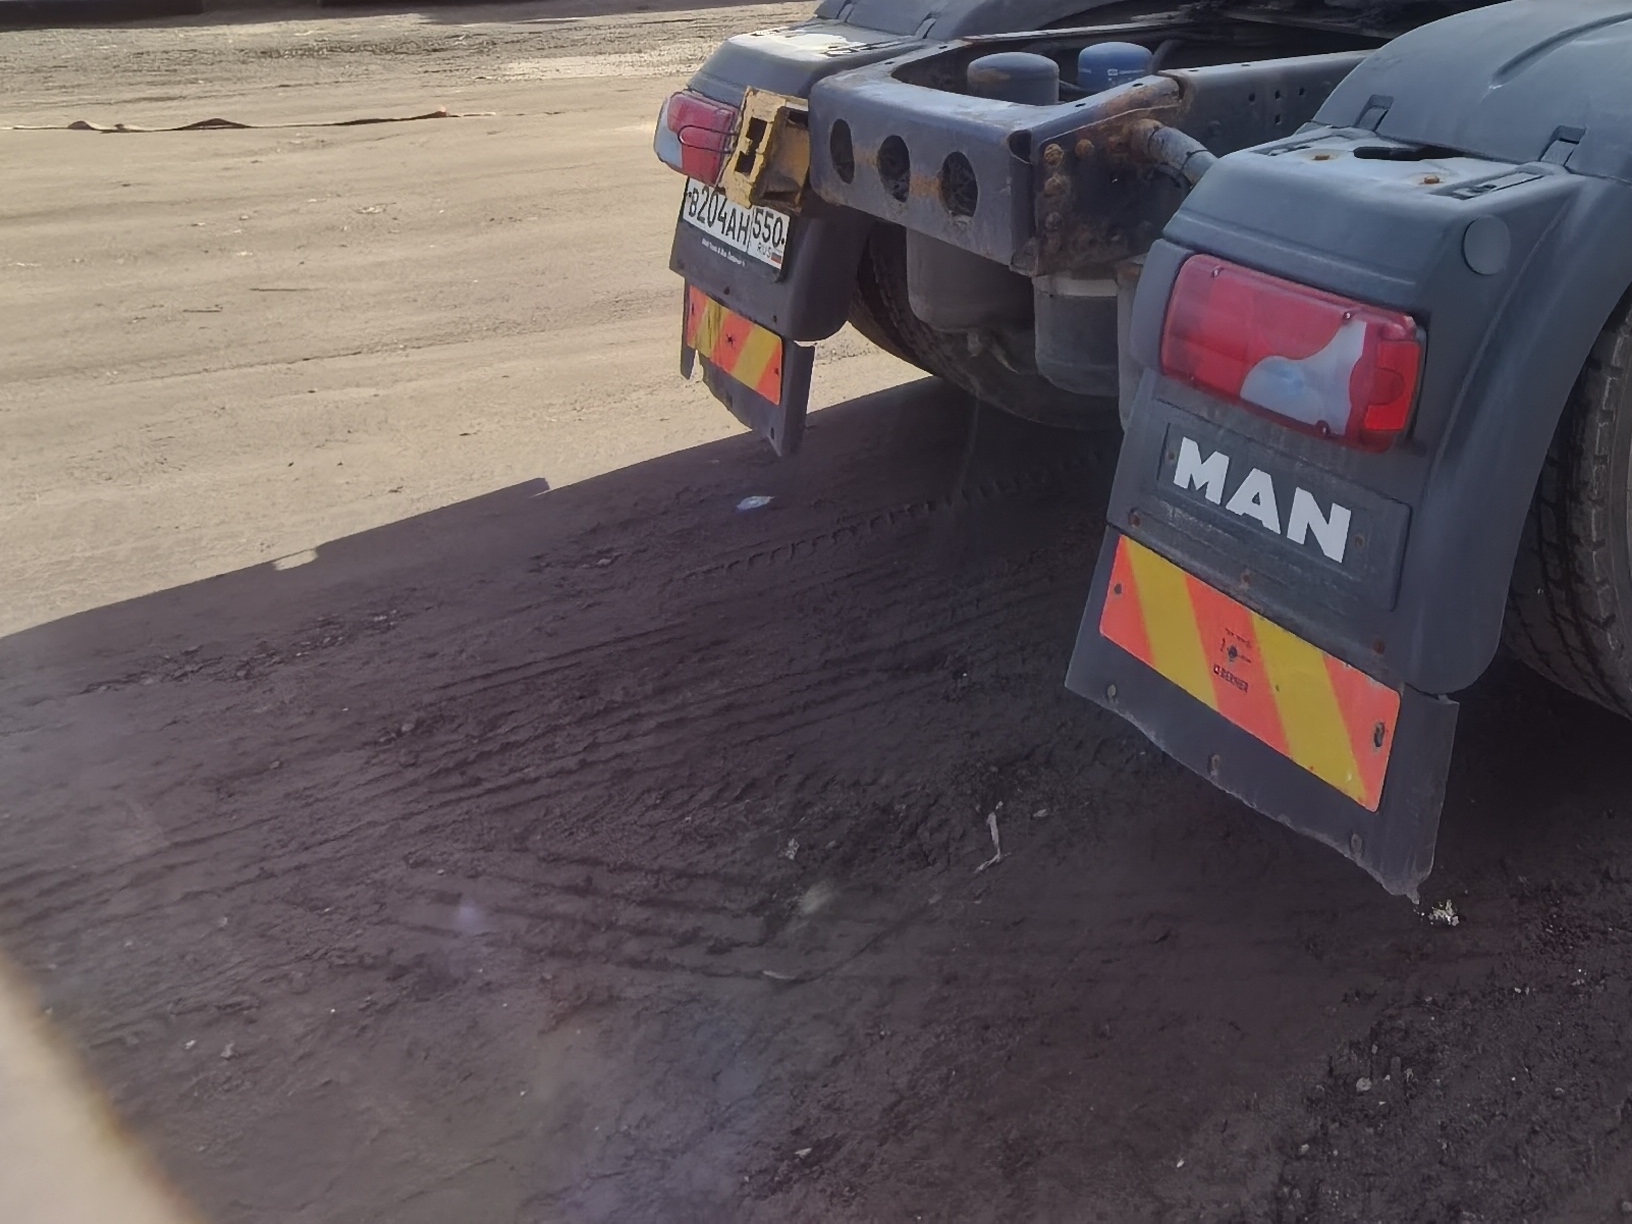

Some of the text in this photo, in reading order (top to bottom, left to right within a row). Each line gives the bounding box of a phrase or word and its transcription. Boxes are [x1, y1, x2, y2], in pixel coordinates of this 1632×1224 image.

[688, 186, 783, 248] В204АН 550
[757, 243, 771, 258] RUS
[1173, 436, 1352, 564] MAN
